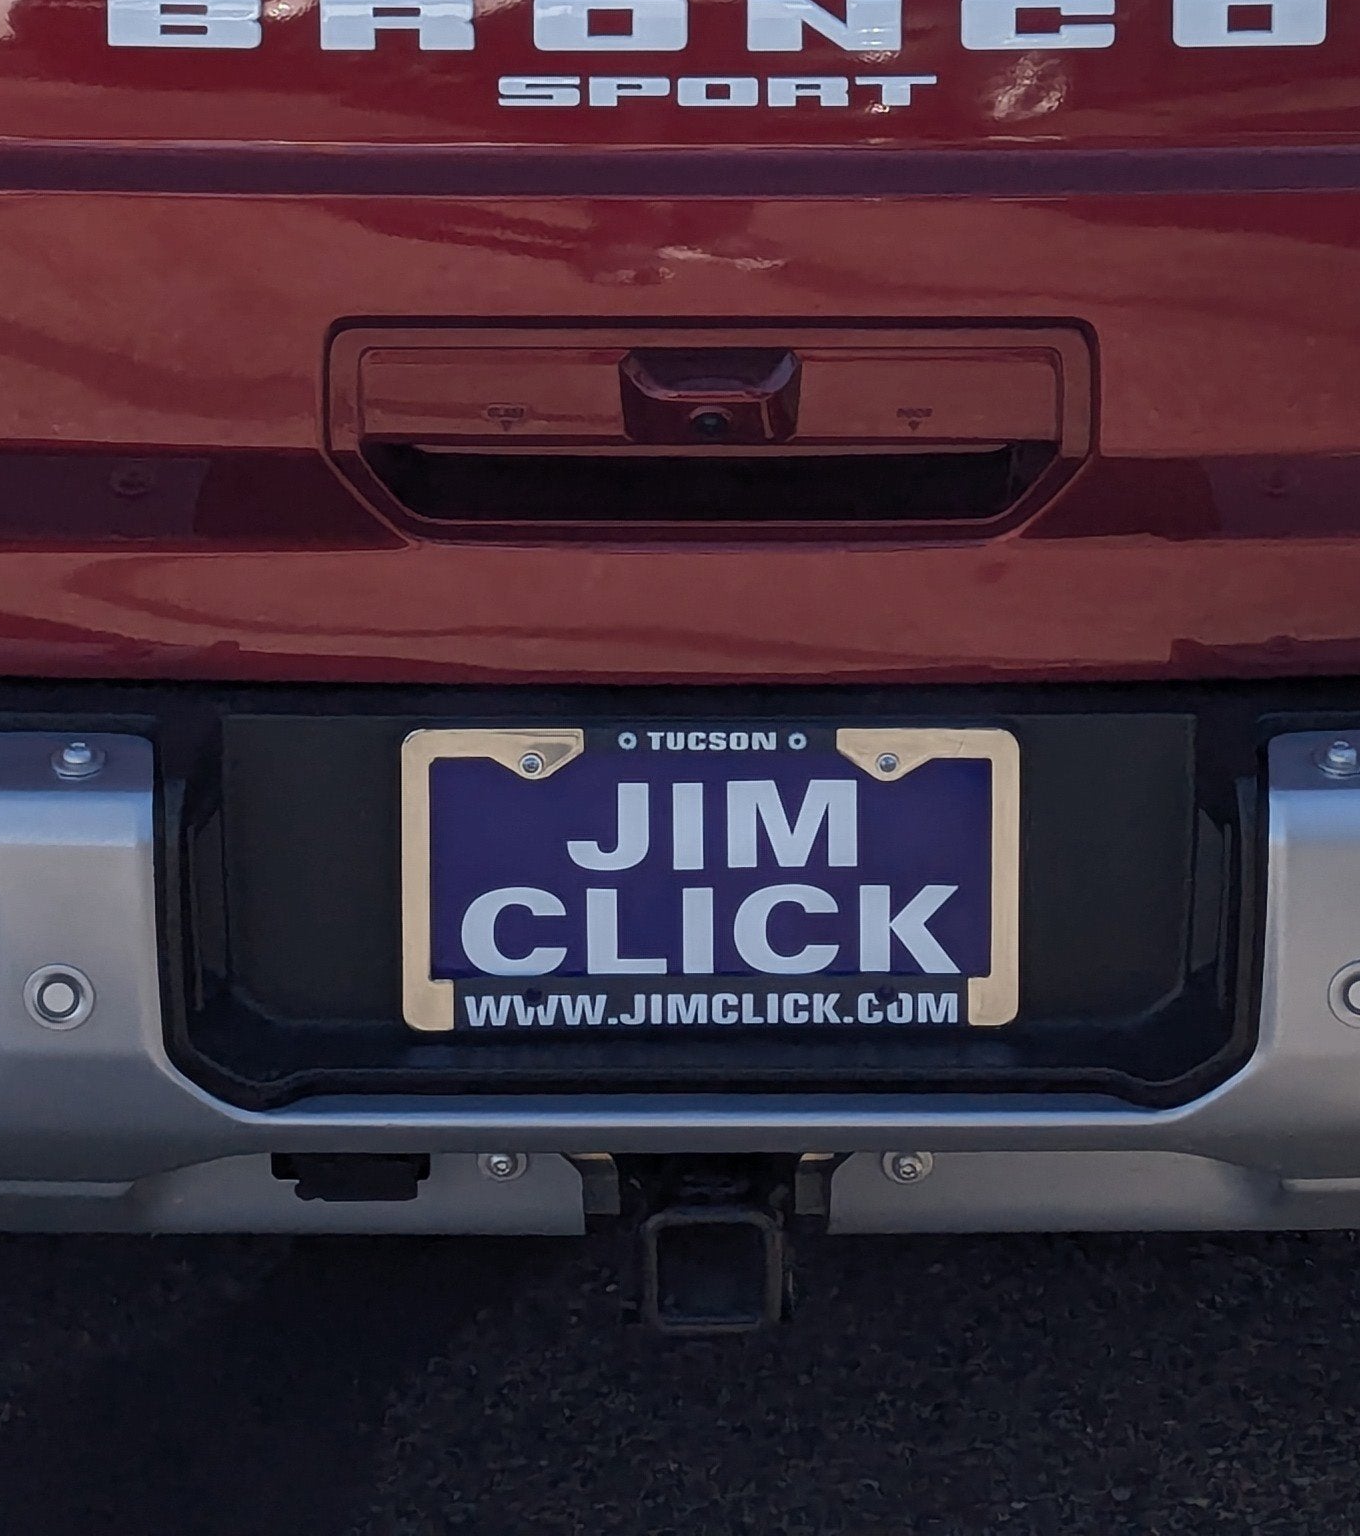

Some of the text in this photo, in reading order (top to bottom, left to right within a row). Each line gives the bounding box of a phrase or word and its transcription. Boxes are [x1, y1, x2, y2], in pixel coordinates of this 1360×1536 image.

[497, 76, 937, 108] SPORT
[647, 732, 777, 751] TUCSON
[567, 779, 858, 871] JIM
[461, 884, 961, 975] CLICK
[465, 992, 958, 1027] WWW.JIMCLICK.COM
